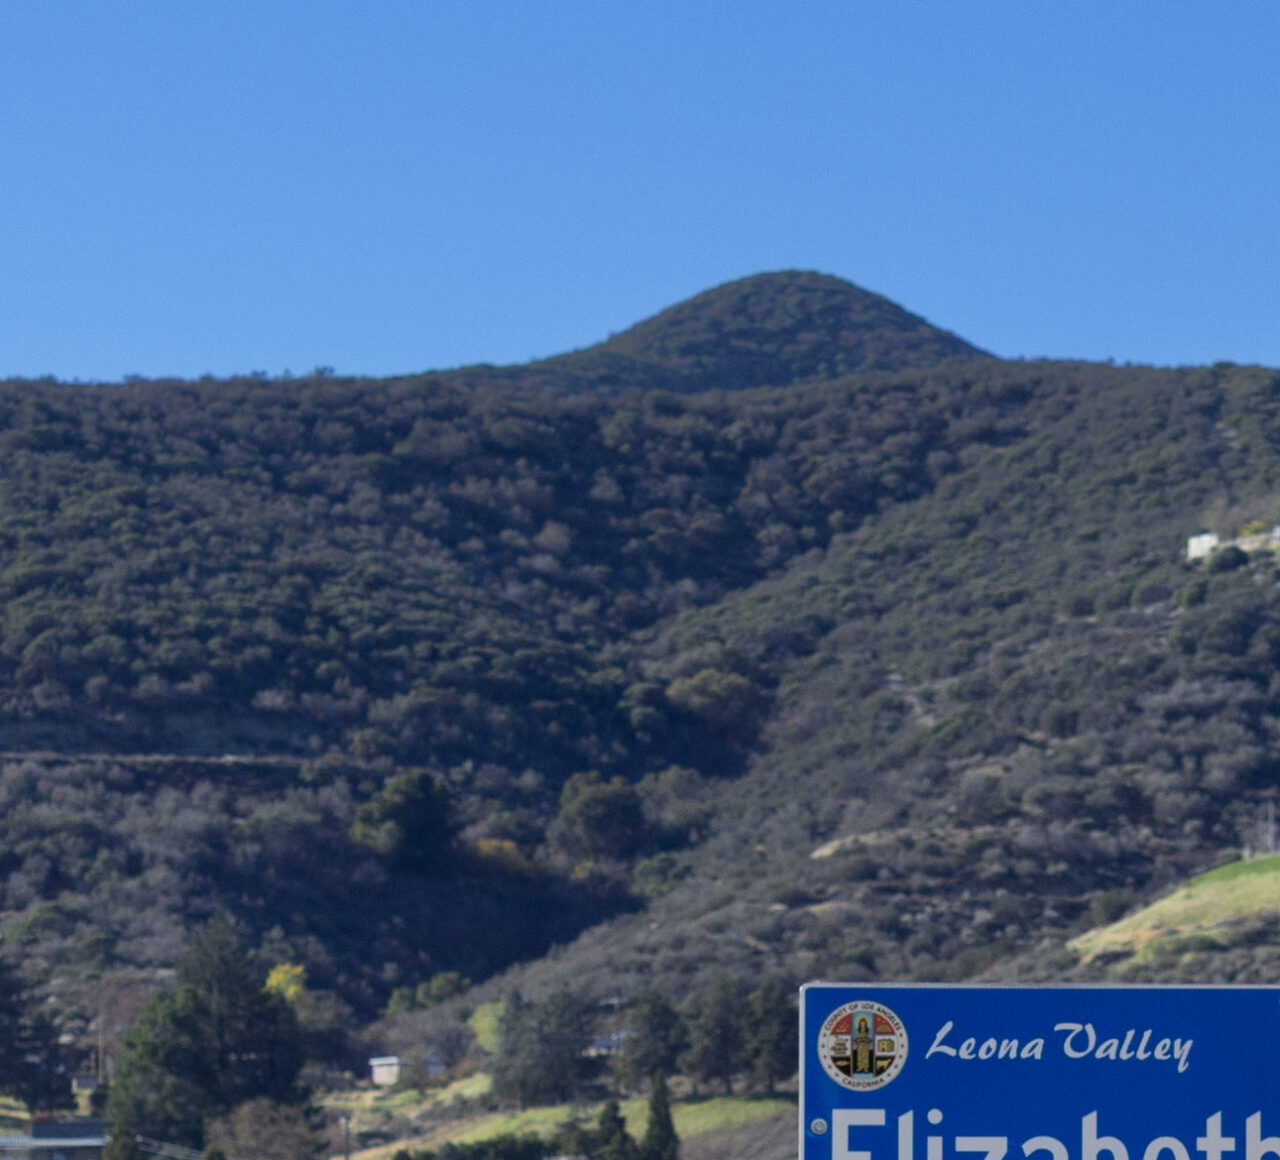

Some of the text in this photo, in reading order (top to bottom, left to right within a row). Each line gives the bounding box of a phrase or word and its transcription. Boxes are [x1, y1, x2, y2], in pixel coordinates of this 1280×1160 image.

[825, 1008, 848, 1031] COUNTY
[876, 1007, 902, 1031] ANGELES
[926, 1022, 1193, 1073] Leona Valley
[842, 1077, 885, 1088] CALIFORNIA
